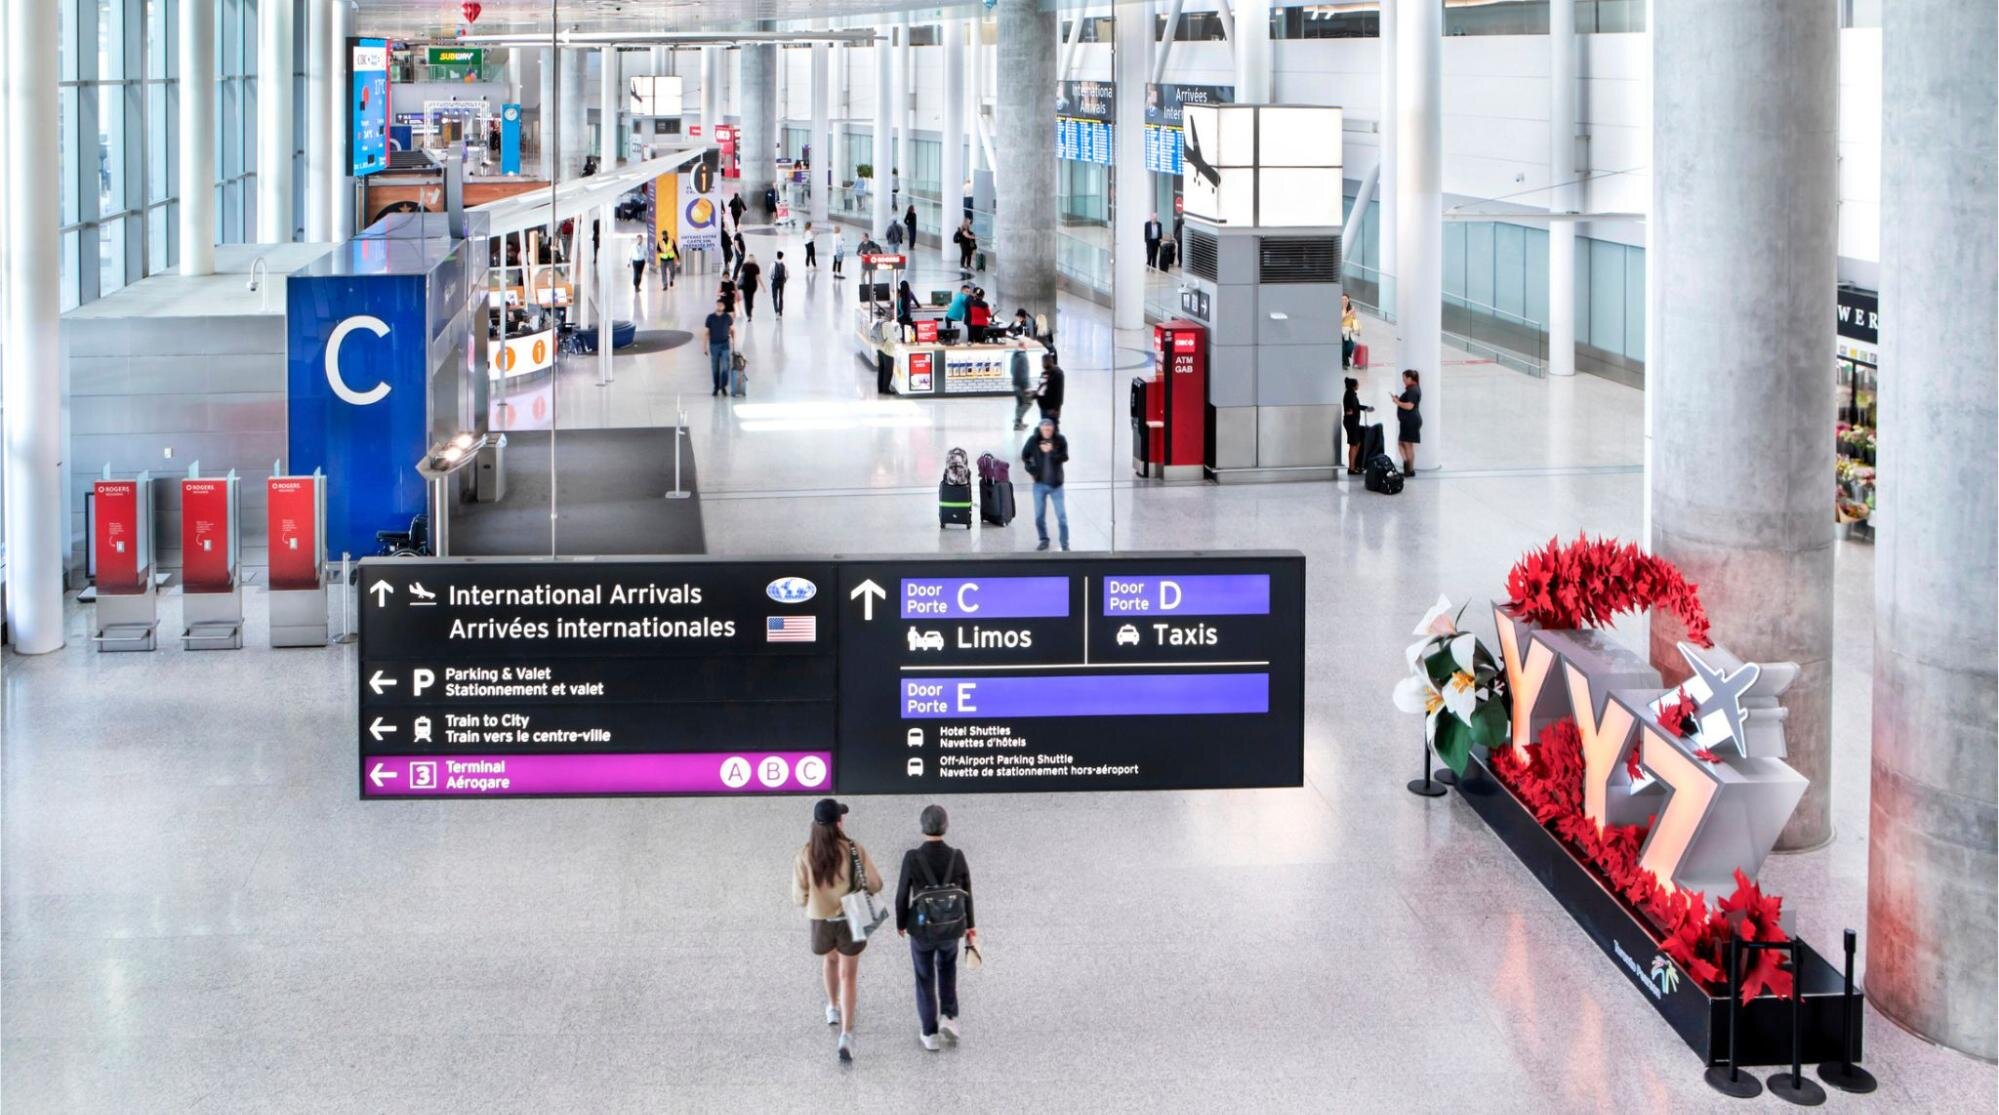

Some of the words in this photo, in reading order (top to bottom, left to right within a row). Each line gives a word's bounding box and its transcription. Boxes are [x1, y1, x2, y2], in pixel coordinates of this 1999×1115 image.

[440, 52, 474, 61] SUBWAY
[1072, 84, 1113, 98] Internationa
[1175, 88, 1208, 102] Arrivées
[324, 314, 393, 406] C
[1175, 356, 1193, 364] ATM
[1175, 365, 1193, 373] GAB
[450, 584, 602, 606] International
[610, 583, 702, 605] Arrivals
[907, 583, 943, 597] Door
[1110, 581, 1145, 594] Door
[956, 582, 980, 613] C
[1159, 581, 1182, 610] D
[907, 599, 948, 614] Porte
[1109, 597, 1150, 611] Porte
[450, 616, 550, 639] Arrivées
[557, 616, 736, 639] internationales
[1153, 623, 1218, 646] Taxis
[957, 626, 1032, 649] Limos
[414, 668, 435, 697] P
[446, 667, 499, 683] Parking
[502, 667, 513, 680] &
[516, 667, 552, 680] Valet
[446, 683, 548, 697] Stationnement
[551, 683, 567, 696] et
[570, 682, 604, 696] valet
[907, 682, 943, 697] Door
[957, 682, 977, 713] E
[907, 699, 948, 713] Porte
[445, 714, 480, 727] Train
[483, 714, 499, 727] to
[502, 714, 530, 729] City
[445, 730, 480, 743] Train
[484, 731, 513, 743] vers
[517, 729, 529, 743] le
[533, 728, 611, 742] centre-ville
[940, 726, 967, 736] Hotel
[970, 726, 1011, 736] Shuttles
[940, 738, 984, 748] Navettes
[446, 760, 506, 774] Terminal
[940, 755, 994, 766] Off-Airport
[997, 755, 1035, 765] Parking
[1037, 754, 1073, 765] Shuttle
[416, 765, 430, 785] 3
[728, 762, 743, 782] A
[766, 761, 781, 781] B
[803, 761, 817, 780] C
[940, 767, 979, 777] Navette
[981, 767, 993, 777] de
[997, 766, 1068, 776] stationnement
[1071, 764, 1139, 776] hors-aéroport
[446, 775, 511, 791] Aérogare
